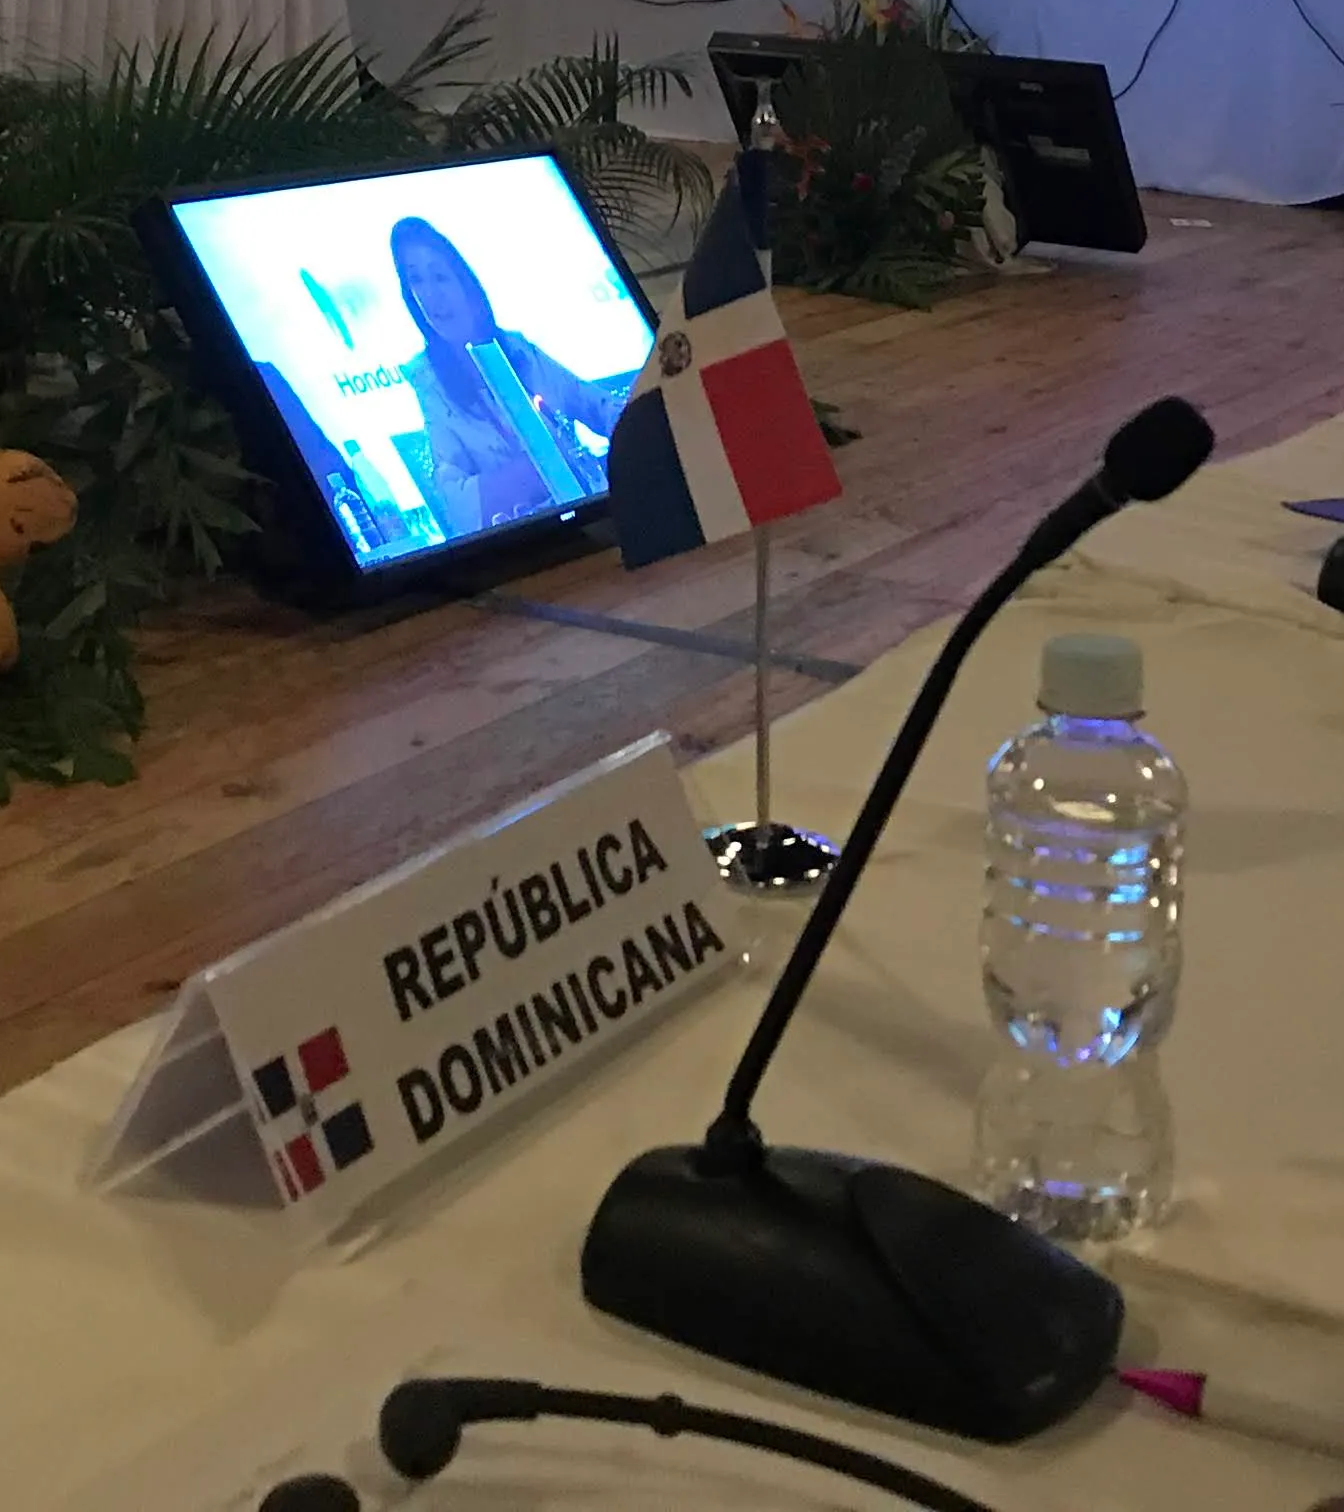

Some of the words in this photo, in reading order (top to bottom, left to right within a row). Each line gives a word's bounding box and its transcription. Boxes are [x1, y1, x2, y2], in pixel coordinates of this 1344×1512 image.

[333, 363, 408, 396] Hondur
[382, 818, 669, 1022] REPÚBLICA
[396, 900, 726, 1144] DOMINICANA
